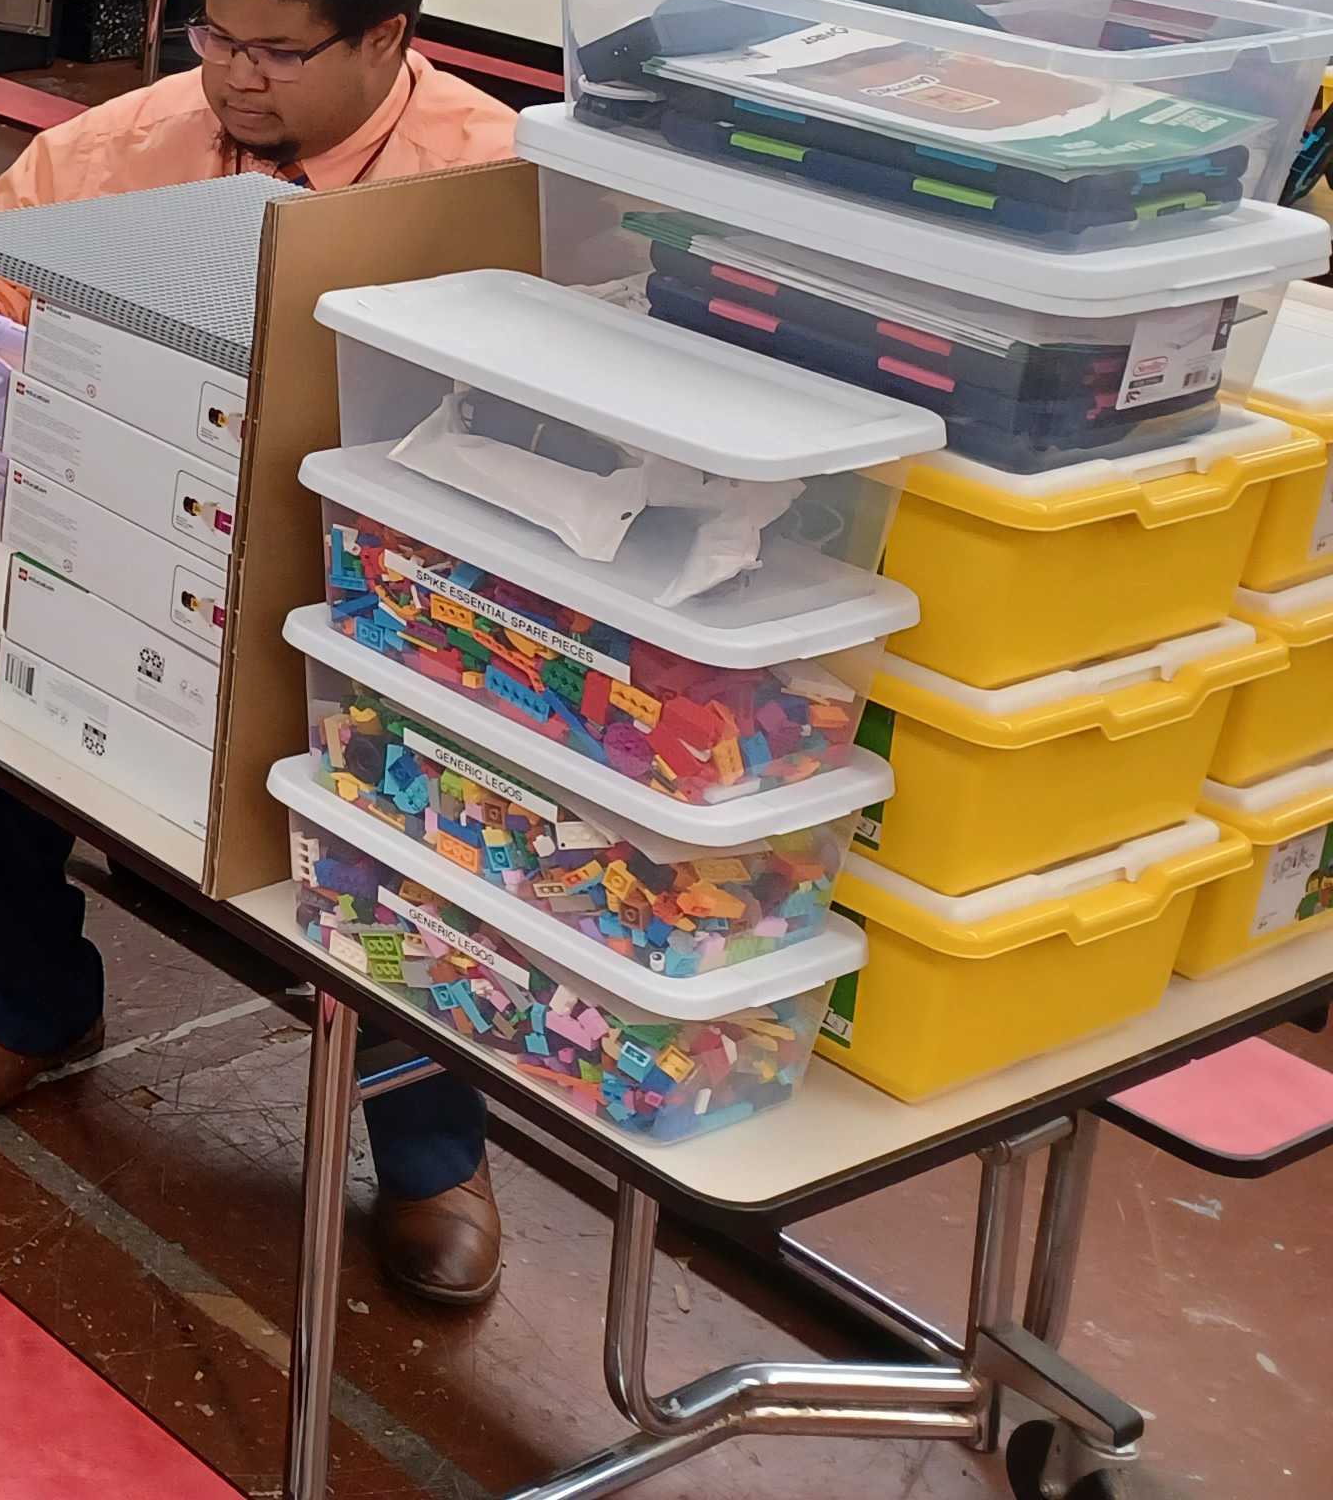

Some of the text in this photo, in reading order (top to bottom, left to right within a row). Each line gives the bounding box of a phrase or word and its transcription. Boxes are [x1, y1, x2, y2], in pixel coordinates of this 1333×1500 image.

[415, 569, 595, 664] SPIKE ESSENTIAL SPARE PIECES
[435, 748, 524, 802] GENERIC LEGOS
[408, 908, 456, 942] GENERIC
